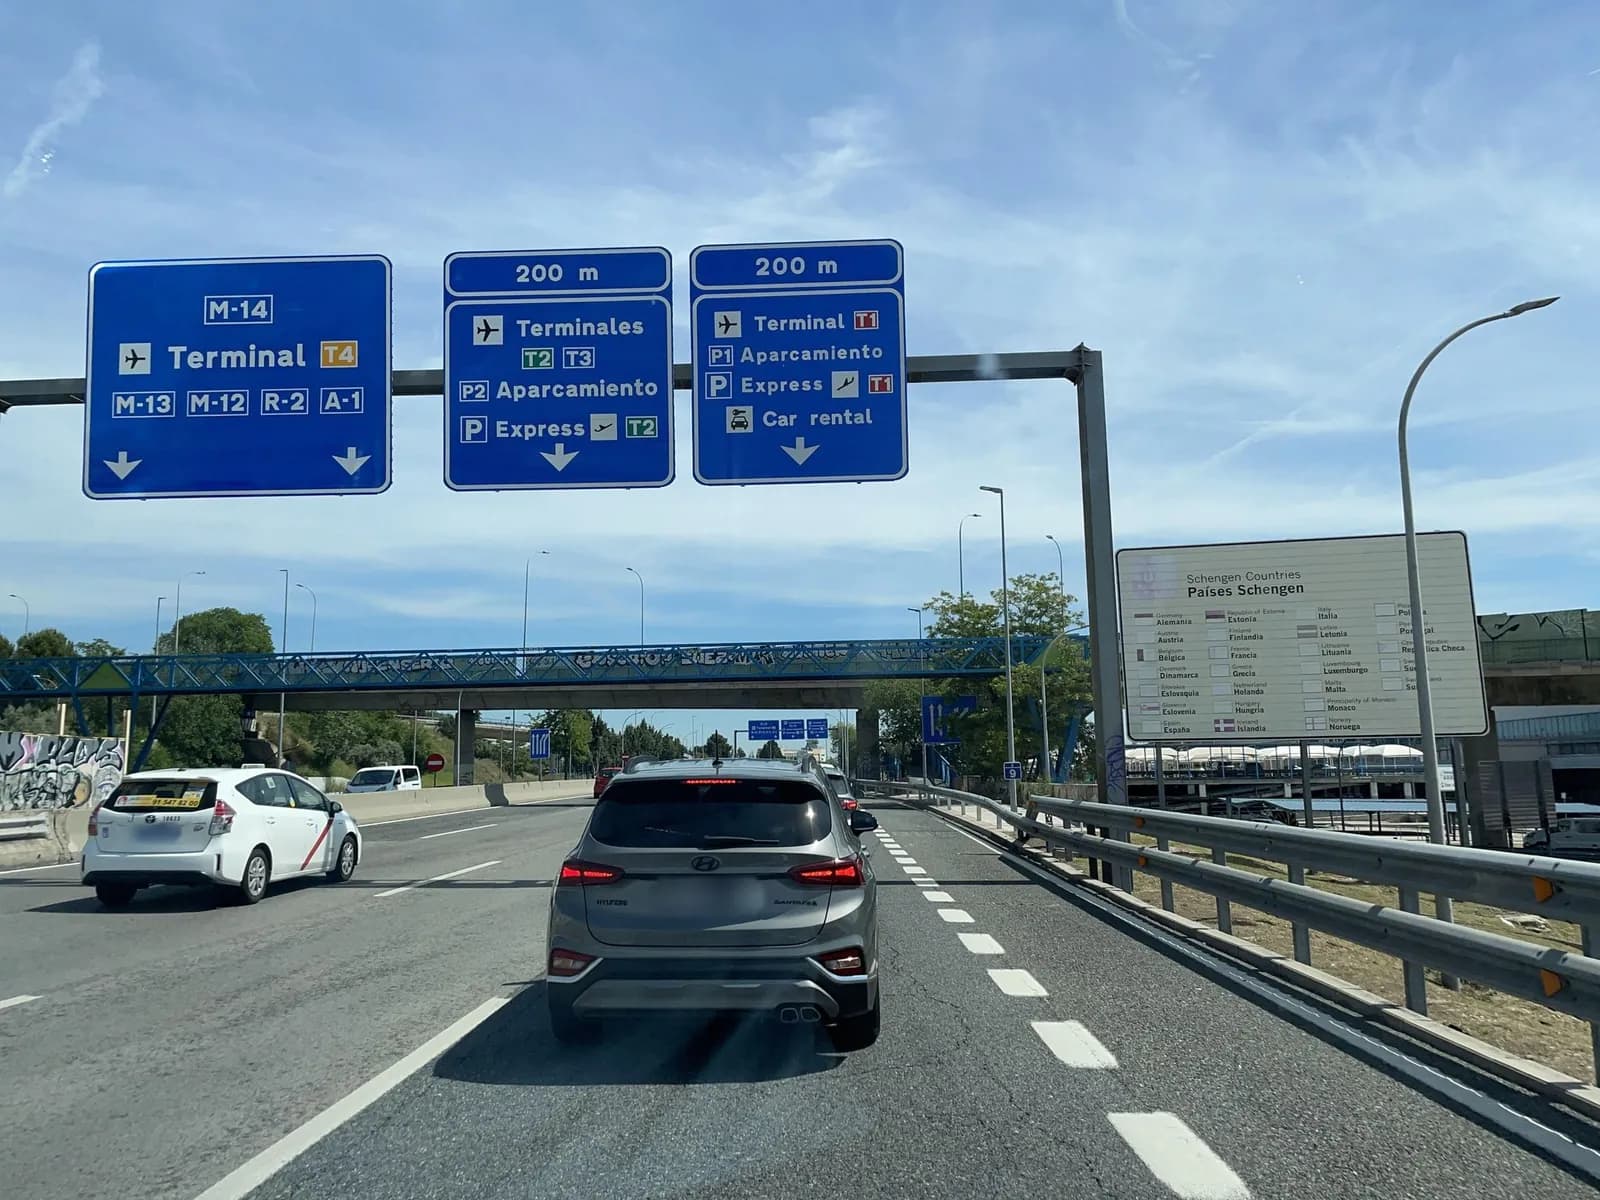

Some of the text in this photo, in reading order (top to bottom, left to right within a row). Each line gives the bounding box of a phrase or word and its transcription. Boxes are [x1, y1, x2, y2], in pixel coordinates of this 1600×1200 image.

[516, 264, 598, 283] 200 m
[755, 257, 838, 276] 200 m
[209, 300, 267, 320] M-14
[516, 317, 644, 337] Terminales
[754, 312, 878, 332] Terminal T1
[168, 344, 355, 369] Terminal T4
[524, 350, 592, 367] T2 T3
[711, 344, 883, 365] P1 Aparcamiento
[462, 379, 658, 402] P2 Aparcamiento
[741, 377, 823, 395] Express
[870, 377, 892, 392] T1
[116, 391, 360, 414] M-13 M-12 R-2 A-1
[763, 409, 872, 427] Car rental
[496, 421, 585, 440] Express
[629, 420, 656, 436] T2
[1187, 571, 1301, 585] Schengen Countries
[1187, 584, 1304, 598] Países Schengen
[1318, 612, 1338, 620] Italia
[1320, 630, 1347, 638] Letonia
[1322, 648, 1352, 656] Lituania
[1323, 667, 1368, 675] Luxemburgo
[1161, 690, 1199, 698] Eslovaquia
[1325, 685, 1346, 693] Malta
[1164, 726, 1190, 734] España
[1329, 723, 1360, 731] Noruega
[1009, 768, 1017, 778] 9
